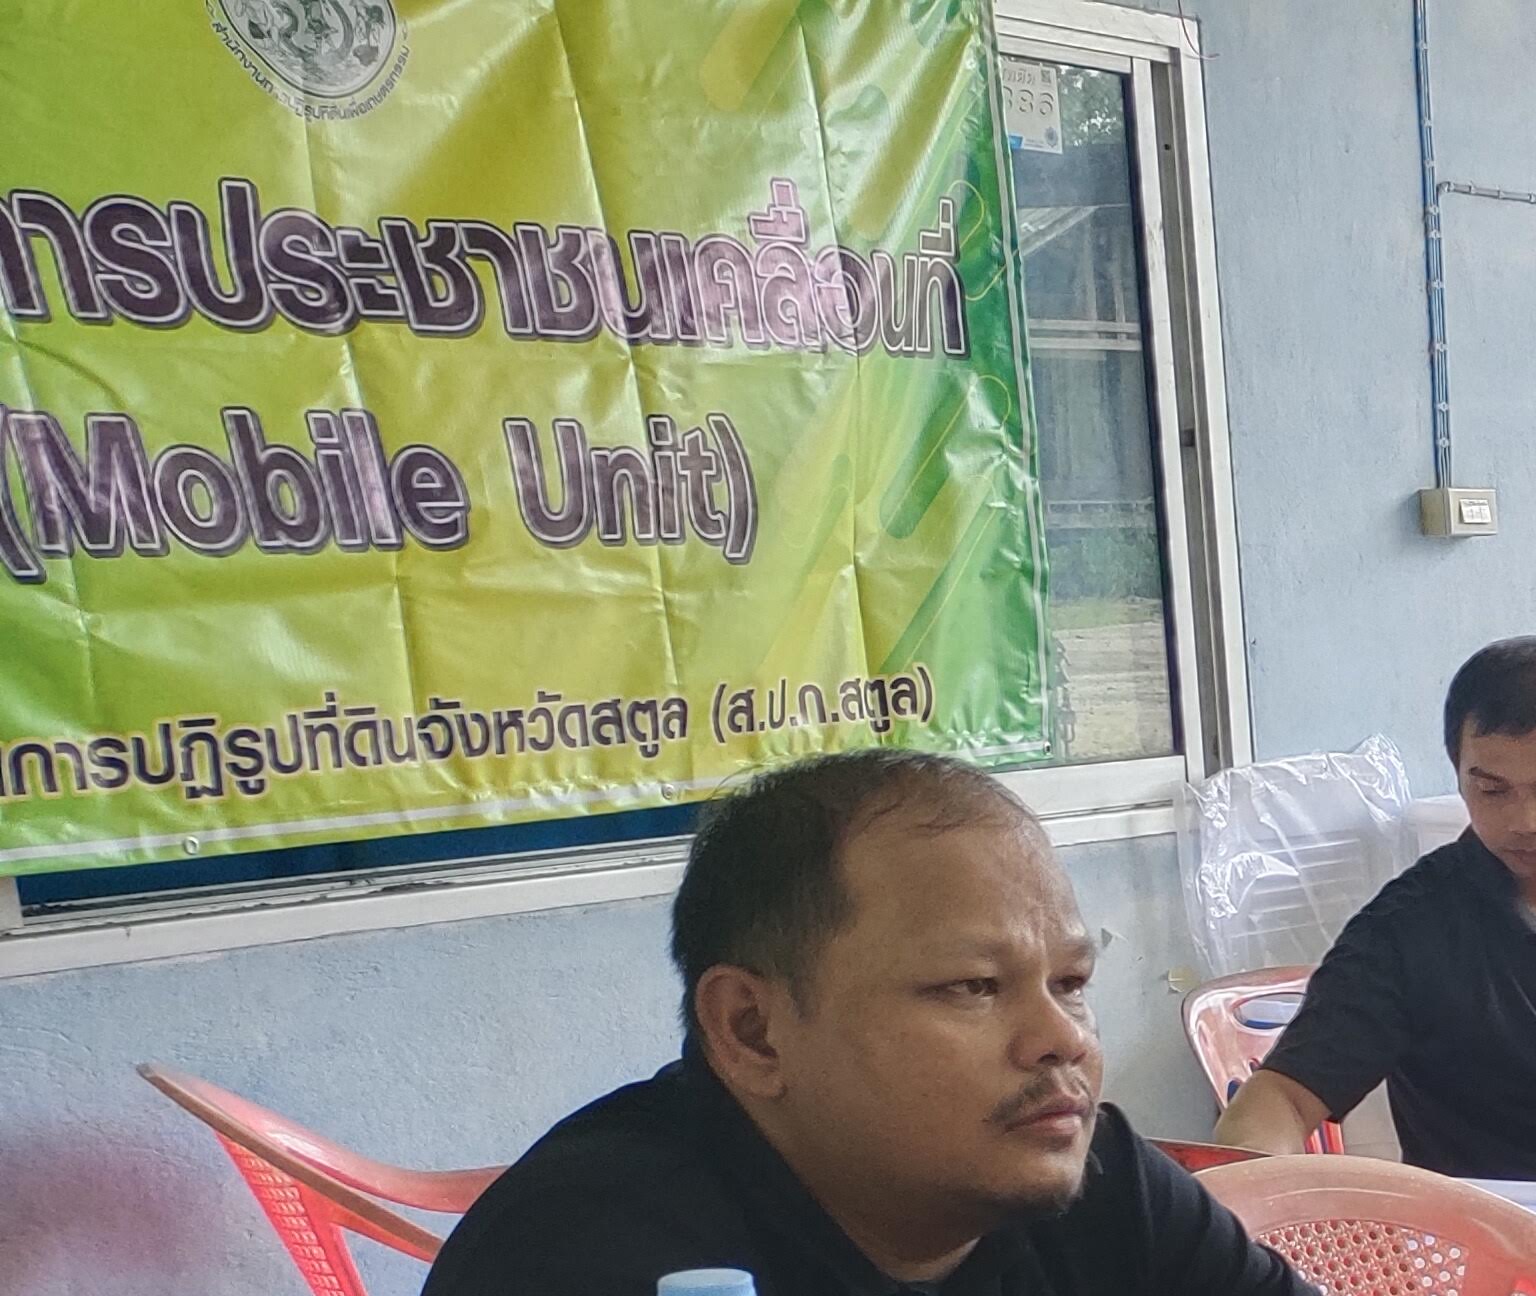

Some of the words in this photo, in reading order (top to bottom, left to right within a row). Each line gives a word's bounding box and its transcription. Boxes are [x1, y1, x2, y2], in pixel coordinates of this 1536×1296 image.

[0, 408, 470, 584] (Mobile
[502, 411, 758, 565] Unit)
[0, 689, 689, 801] การปฏิรูปที่ดินจังหวัดสตูล
[711, 664, 936, 745] (ส.ป.ก.สตูล)
